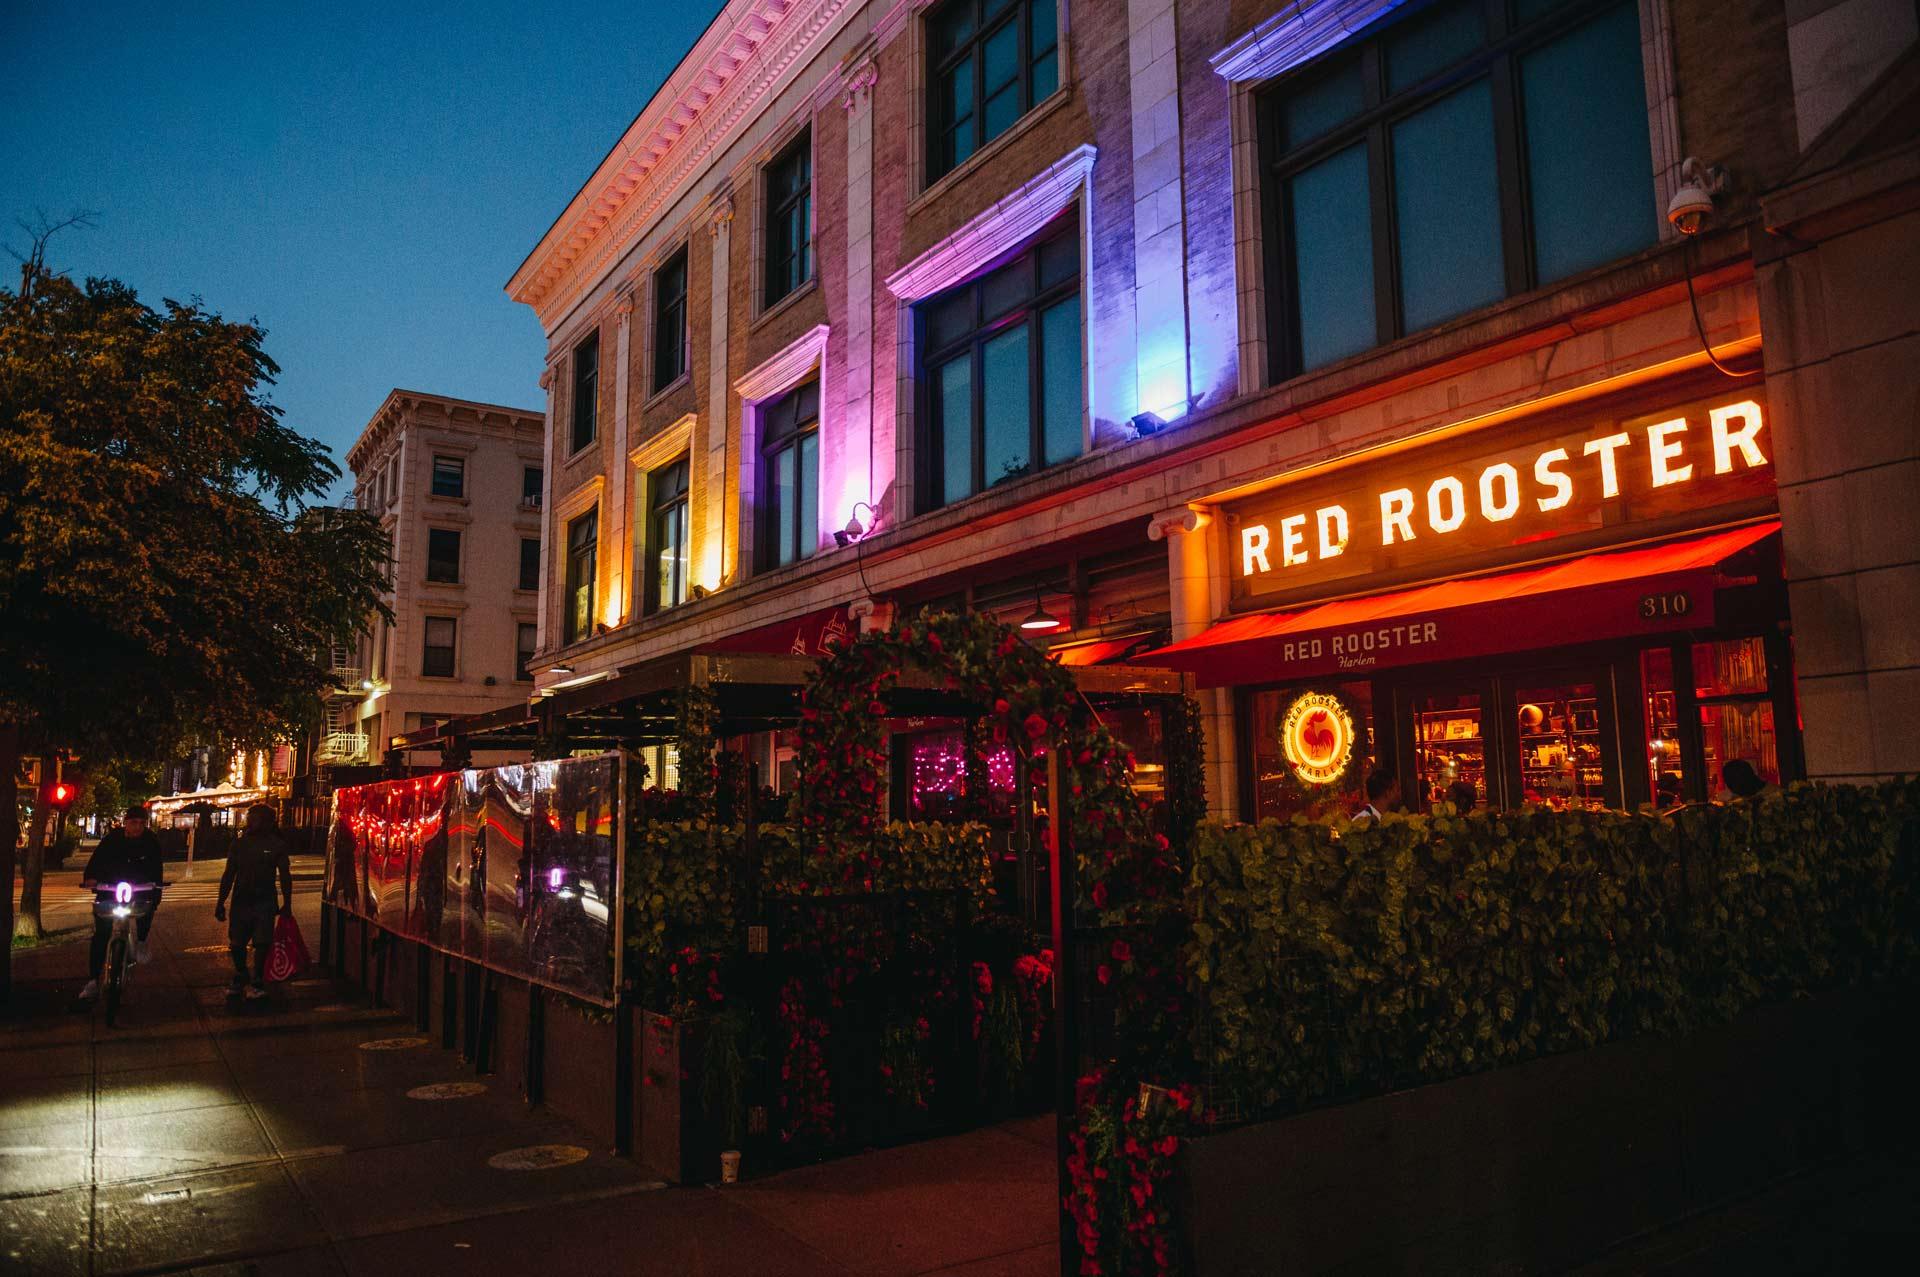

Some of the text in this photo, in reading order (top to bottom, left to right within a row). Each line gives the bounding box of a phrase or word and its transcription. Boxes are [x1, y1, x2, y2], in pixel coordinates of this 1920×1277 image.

[1241, 400, 1769, 576] RED ROOSTER
[1644, 594, 1688, 617] 310
[1283, 622, 1438, 662] RED ROOSTER
[1337, 653, 1377, 669] Harlem
[1289, 696, 1346, 728] RED ROOSTER
[1300, 758, 1344, 778] HARLEM
